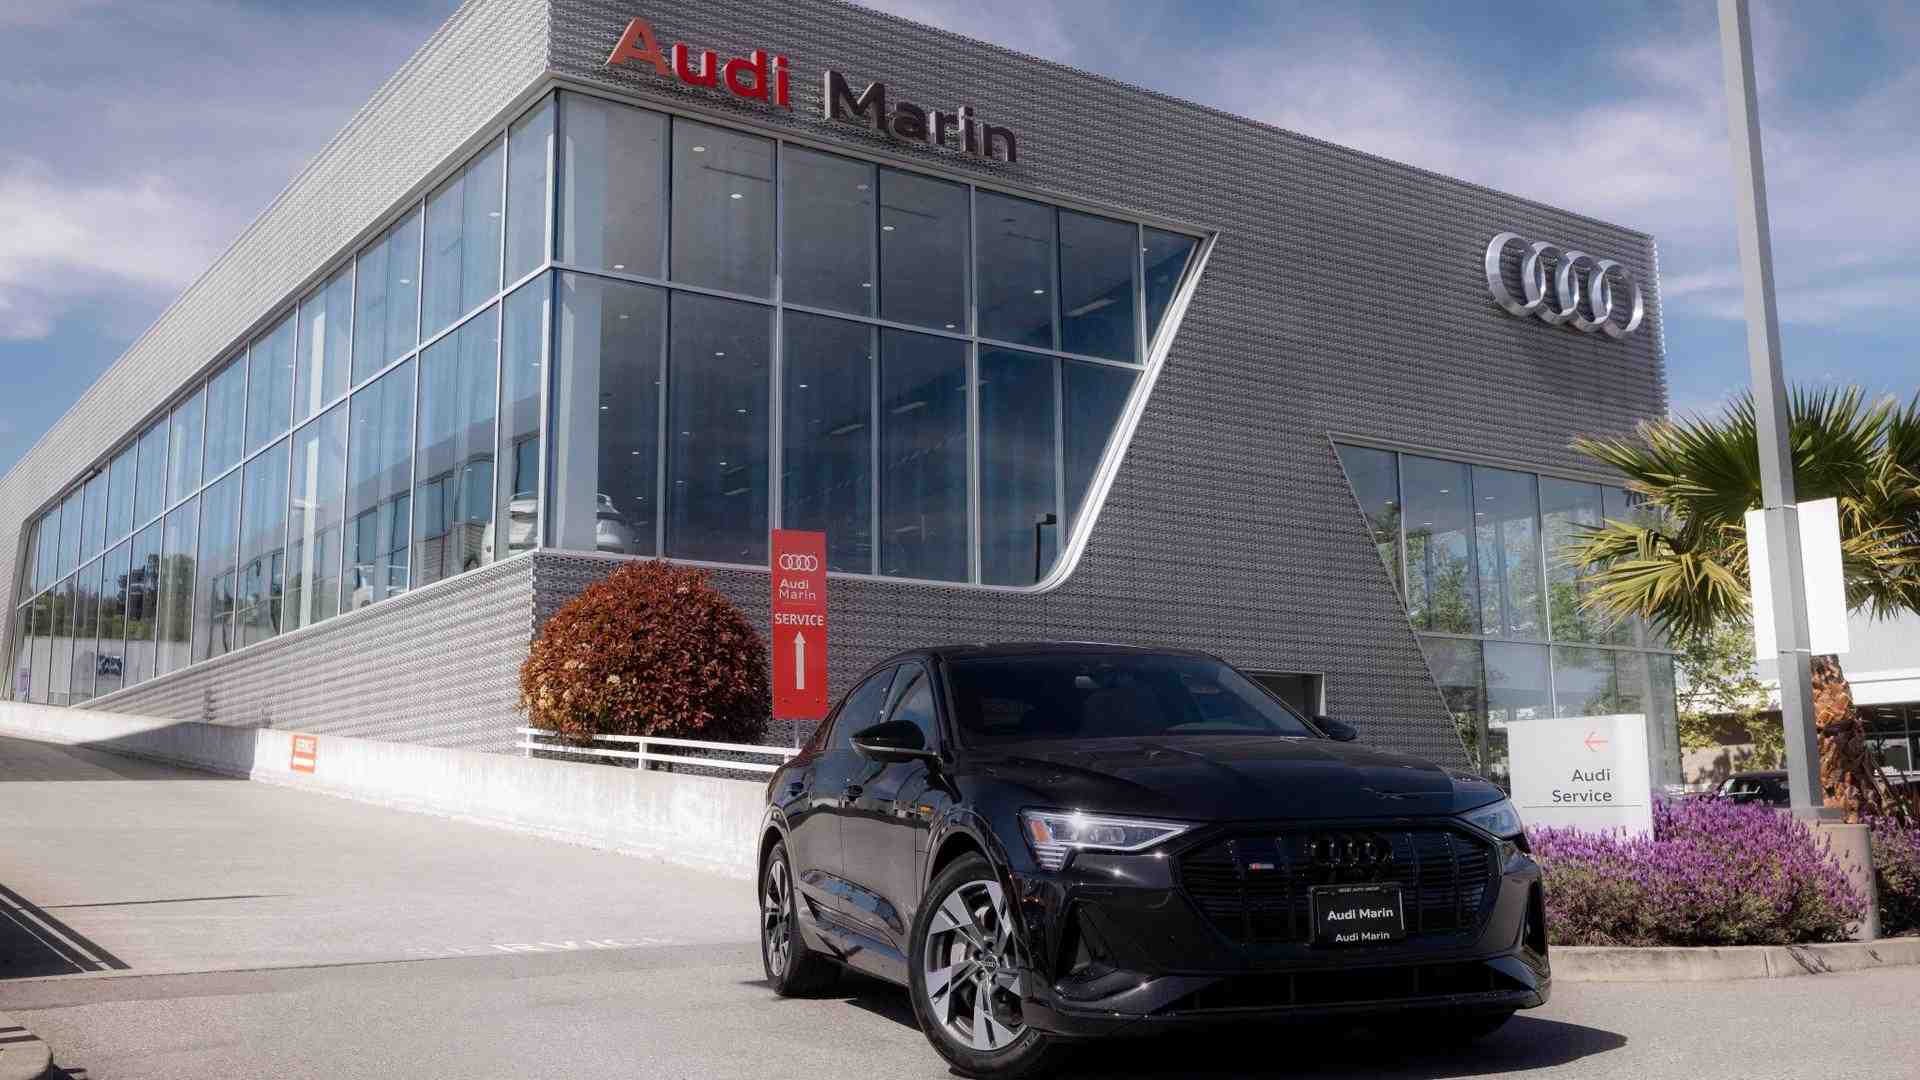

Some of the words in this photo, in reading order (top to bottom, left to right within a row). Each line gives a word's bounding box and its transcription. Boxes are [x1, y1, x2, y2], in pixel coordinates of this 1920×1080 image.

[605, 16, 793, 112] Audi
[823, 69, 1017, 162] Marin
[779, 578, 809, 589] Audi
[779, 590, 816, 601] Marin
[775, 613, 824, 626] SERVICE
[1571, 768, 1611, 782] Audi
[1552, 790, 1612, 803] Service
[1327, 909, 1356, 921] Audi
[1359, 907, 1394, 919] Marin
[1335, 933, 1359, 942] Audi
[1361, 931, 1390, 941] Marin
